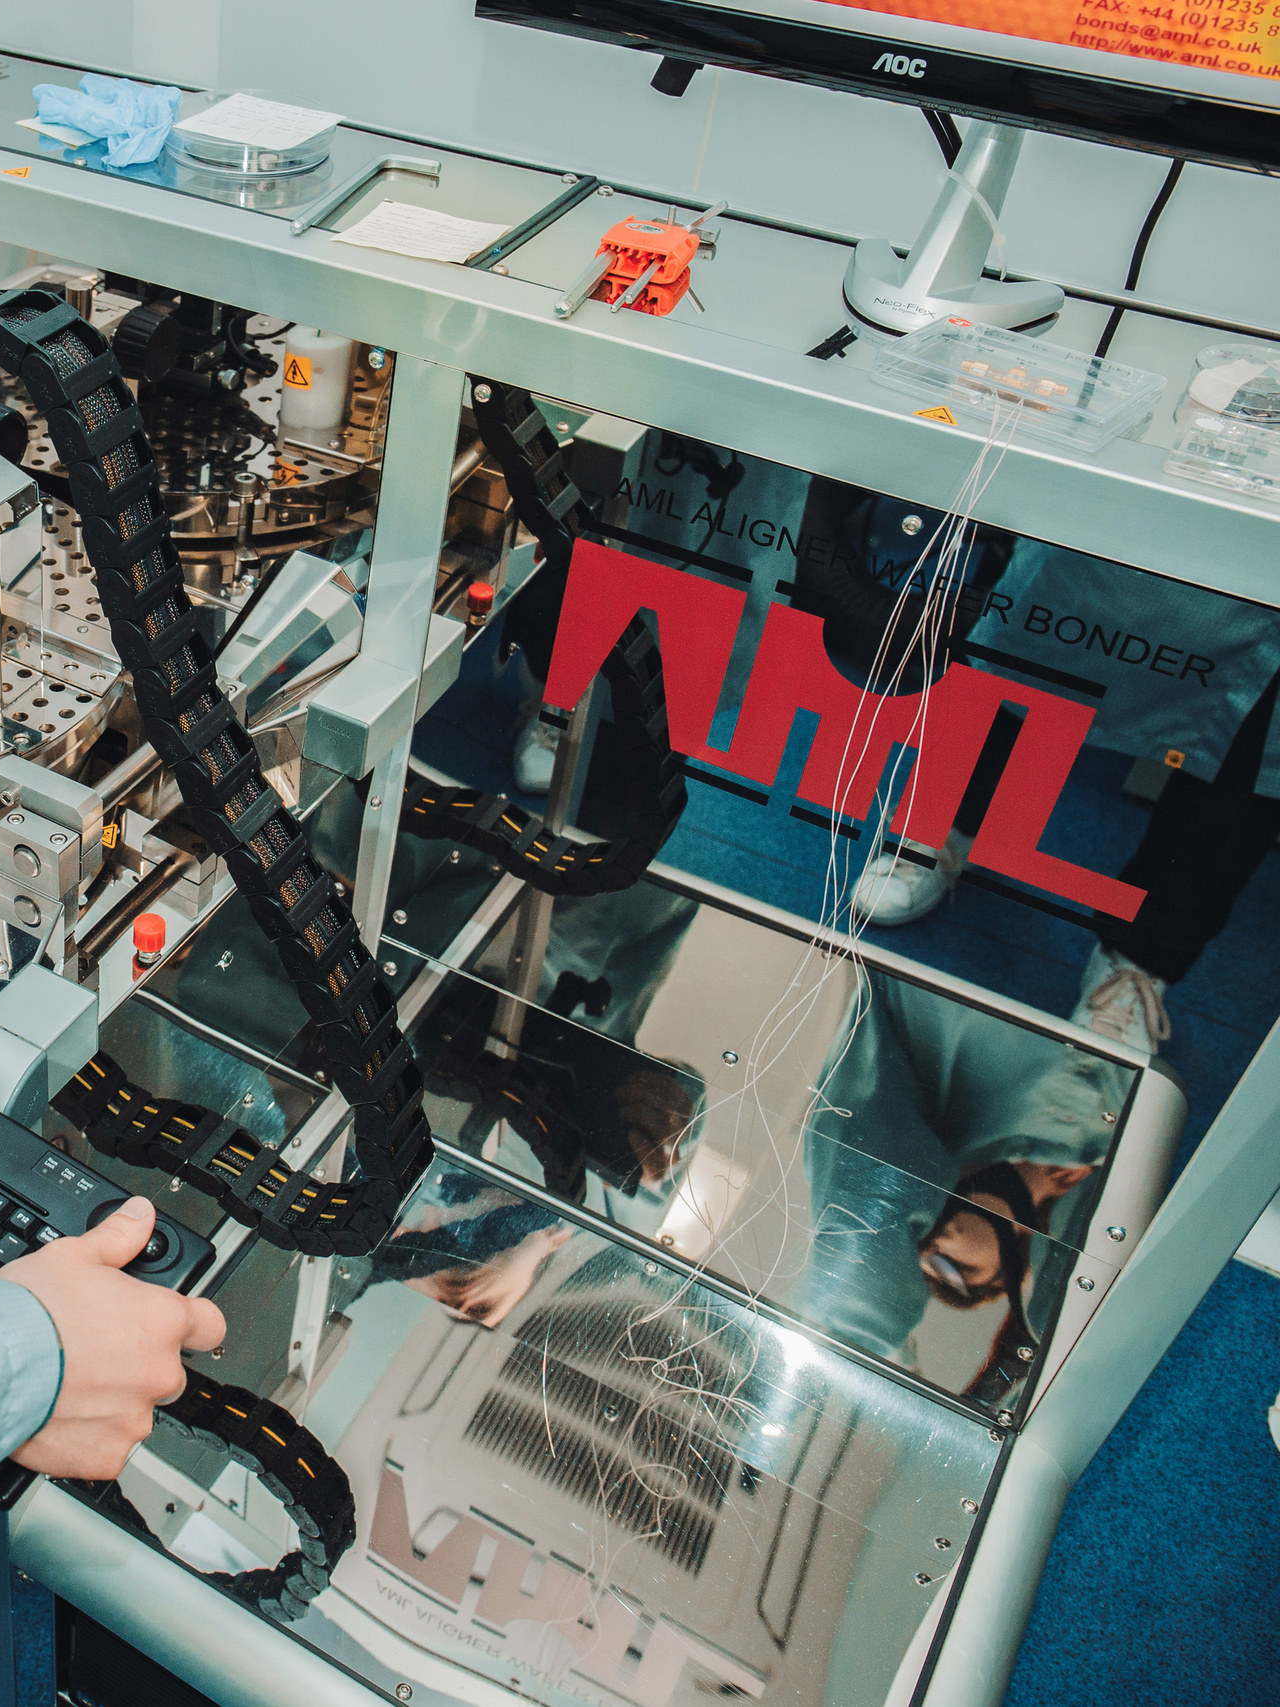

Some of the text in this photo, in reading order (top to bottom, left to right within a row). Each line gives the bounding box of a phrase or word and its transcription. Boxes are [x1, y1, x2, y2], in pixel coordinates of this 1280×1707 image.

[1075, 13, 1264, 55] bonds@aml.co.uk
[1138, 6, 1174, 21] +44
[1180, 12, 1260, 35] (0)1235
[1267, 24, 1280, 38] 8
[871, 52, 927, 79] AOC
[1069, 31, 1280, 78] http://www.aml.co.uk
[873, 297, 937, 319] Neo-Flex
[610, 476, 1216, 688] AML ALIGNER WAFER BONDER
[16, 1212, 30, 1224] F12
